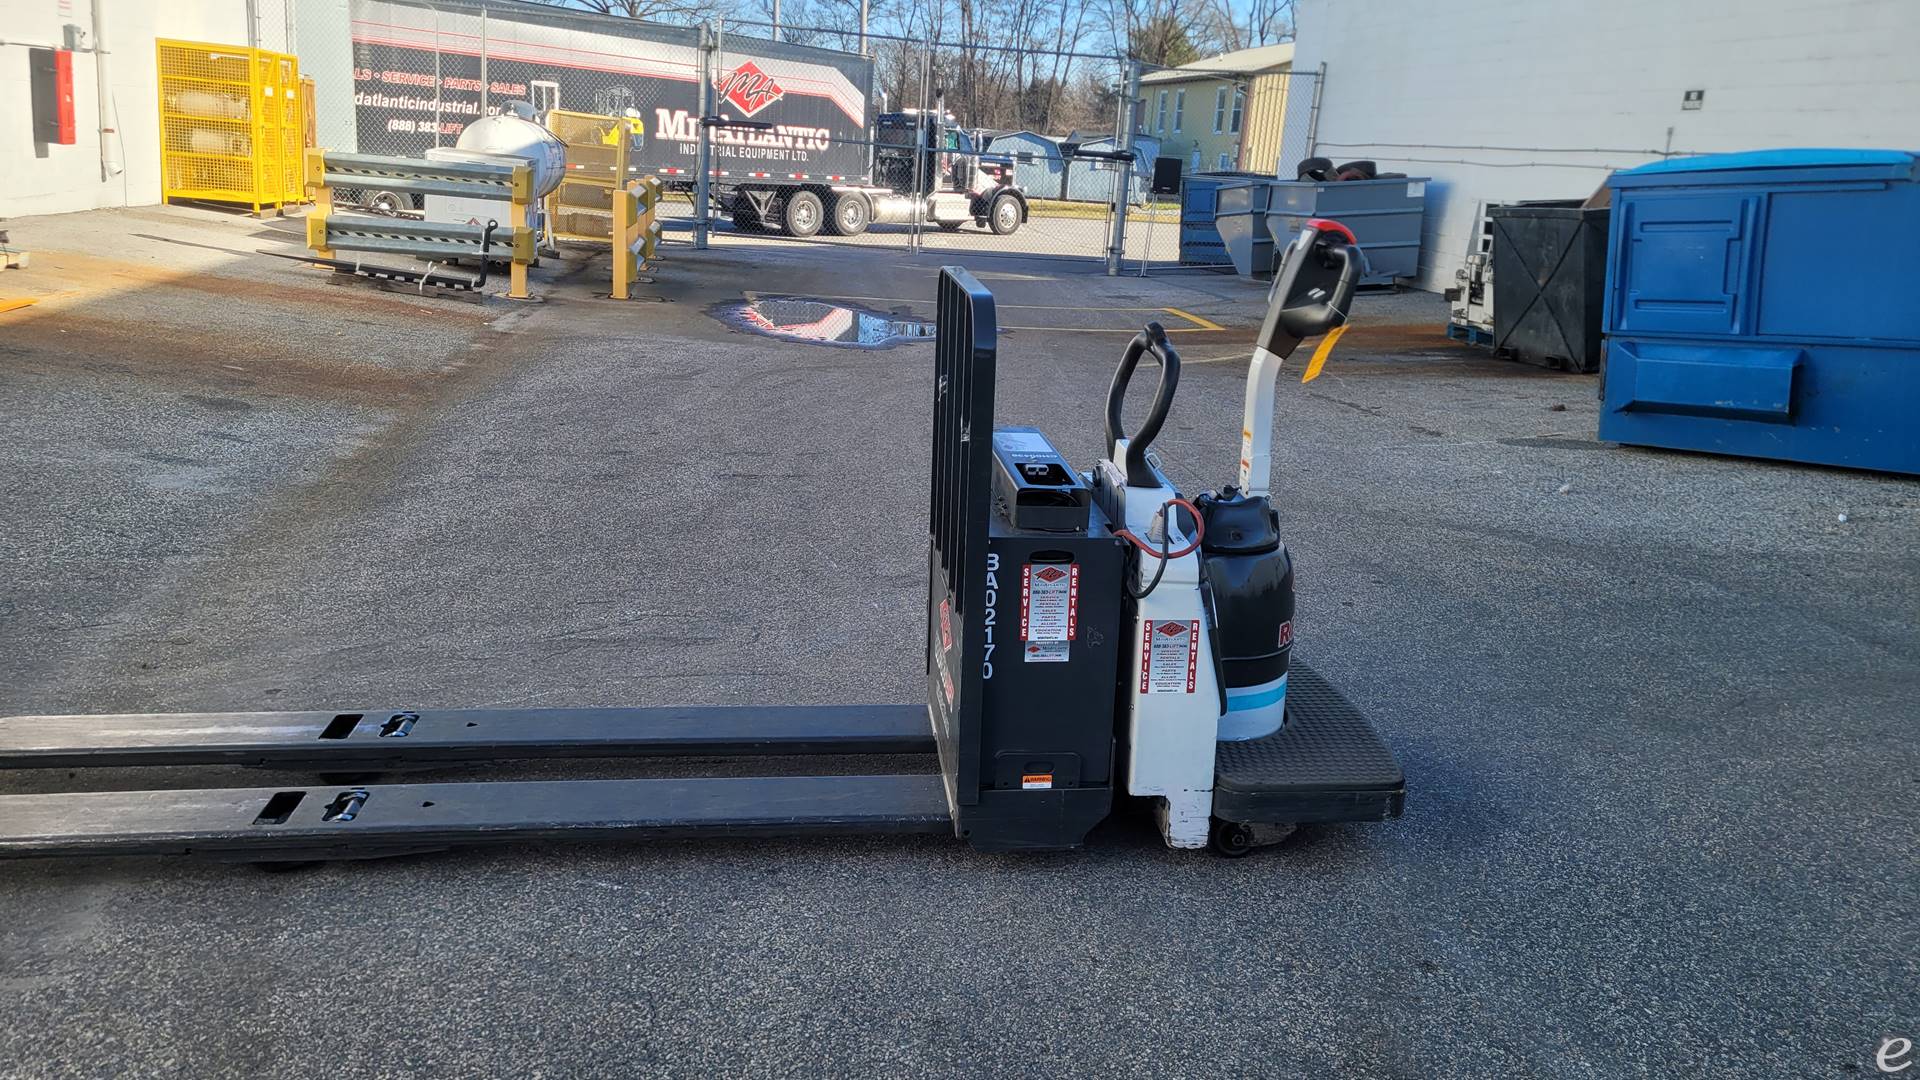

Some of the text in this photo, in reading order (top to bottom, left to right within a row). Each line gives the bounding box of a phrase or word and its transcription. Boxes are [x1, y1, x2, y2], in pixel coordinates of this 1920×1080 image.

[381, 71, 436, 88] SERVICE
[443, 77, 482, 92] PARTS
[490, 81, 527, 96] SALES
[388, 119, 416, 133] (888)
[739, 146, 790, 160] EQUIPMENT
[791, 150, 809, 162] LTD.
[1021, 567, 1030, 637] SERVICE
[1068, 567, 1078, 637] RENTALS
[1141, 622, 1151, 690] SERVICE
[1188, 622, 1199, 690] RENTALS
